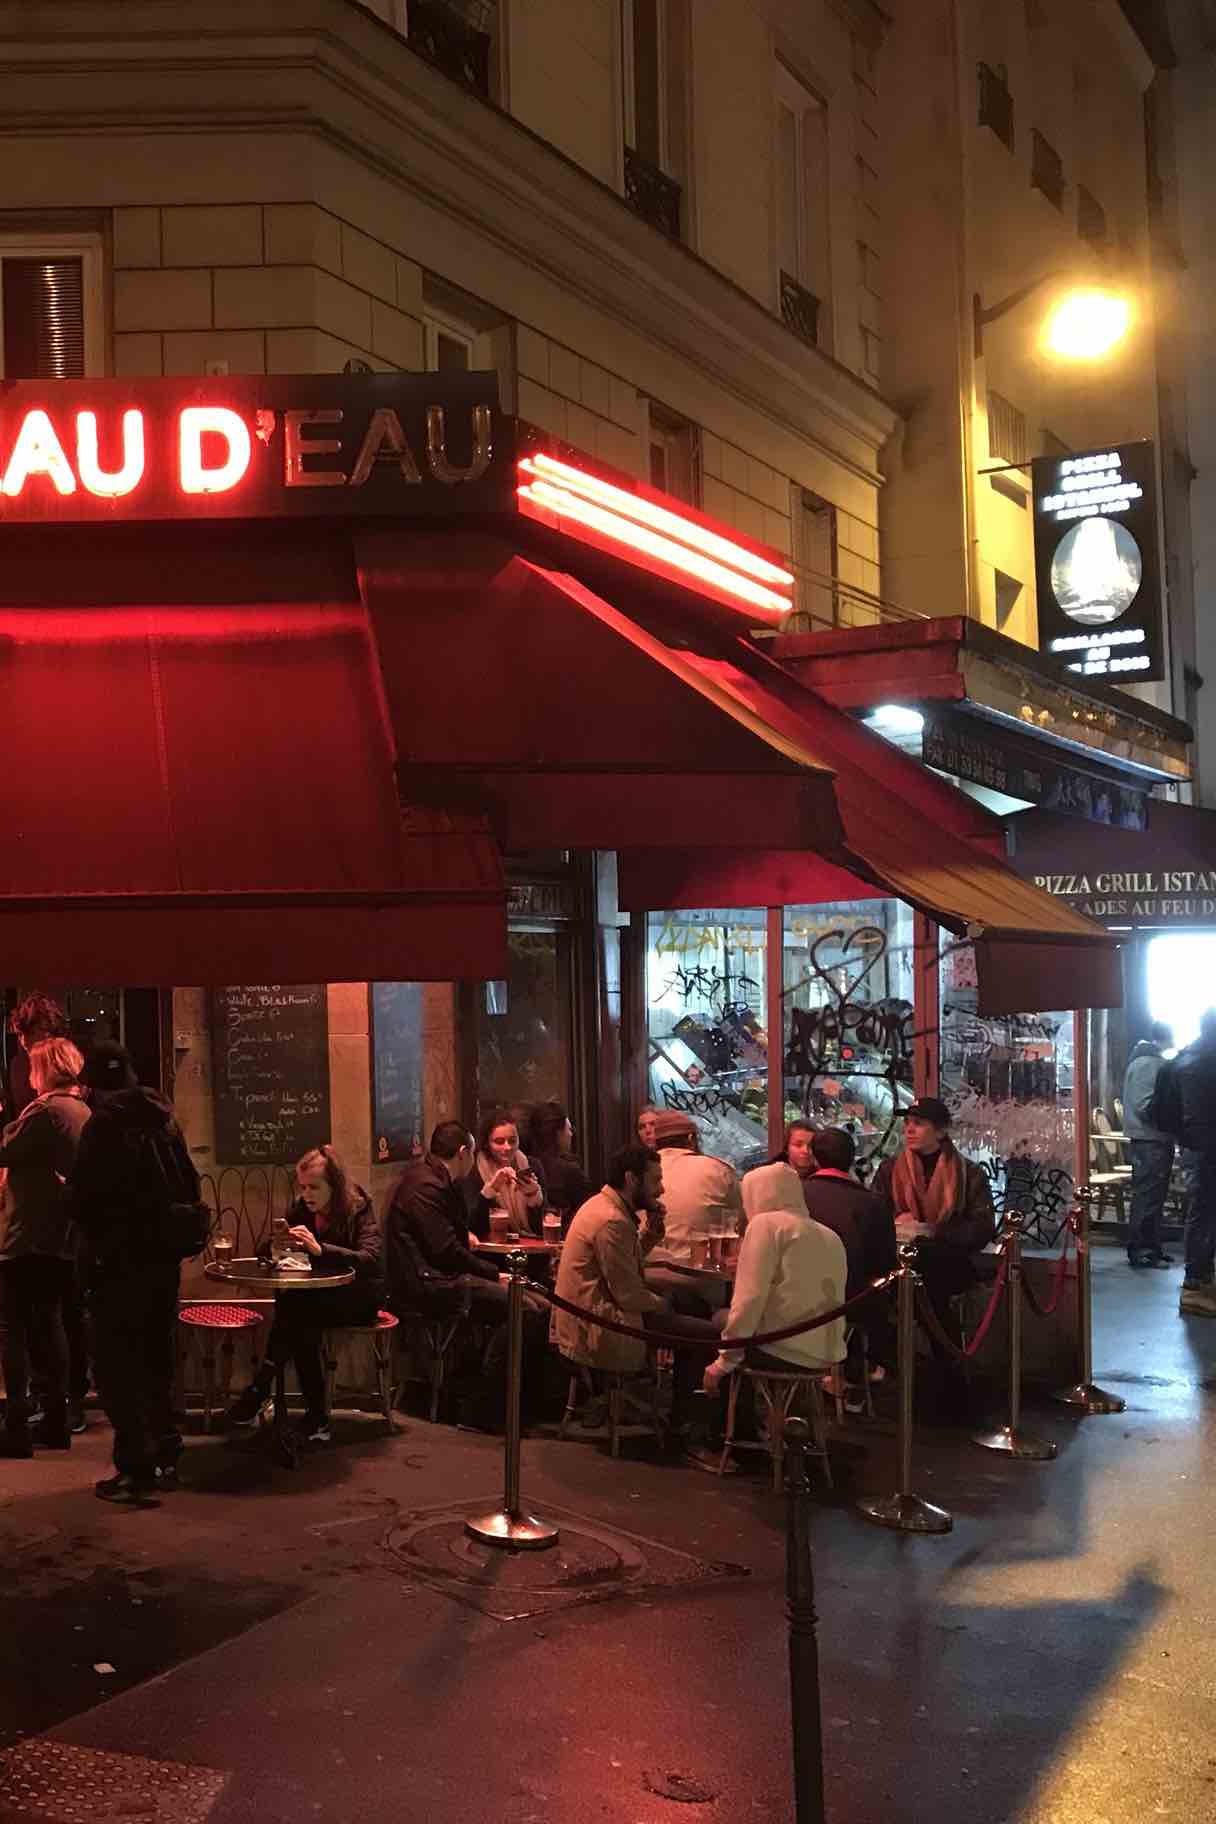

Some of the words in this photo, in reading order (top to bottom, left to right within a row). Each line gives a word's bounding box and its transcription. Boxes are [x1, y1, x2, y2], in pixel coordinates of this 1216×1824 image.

[177, 402, 496, 495] D'EAU
[1034, 875, 1092, 895] PIZZA
[1096, 872, 1158, 893] GRILL
[1132, 899, 1158, 915] AU
[1161, 899, 1200, 915] FEU
[1202, 898, 1216, 914] D
